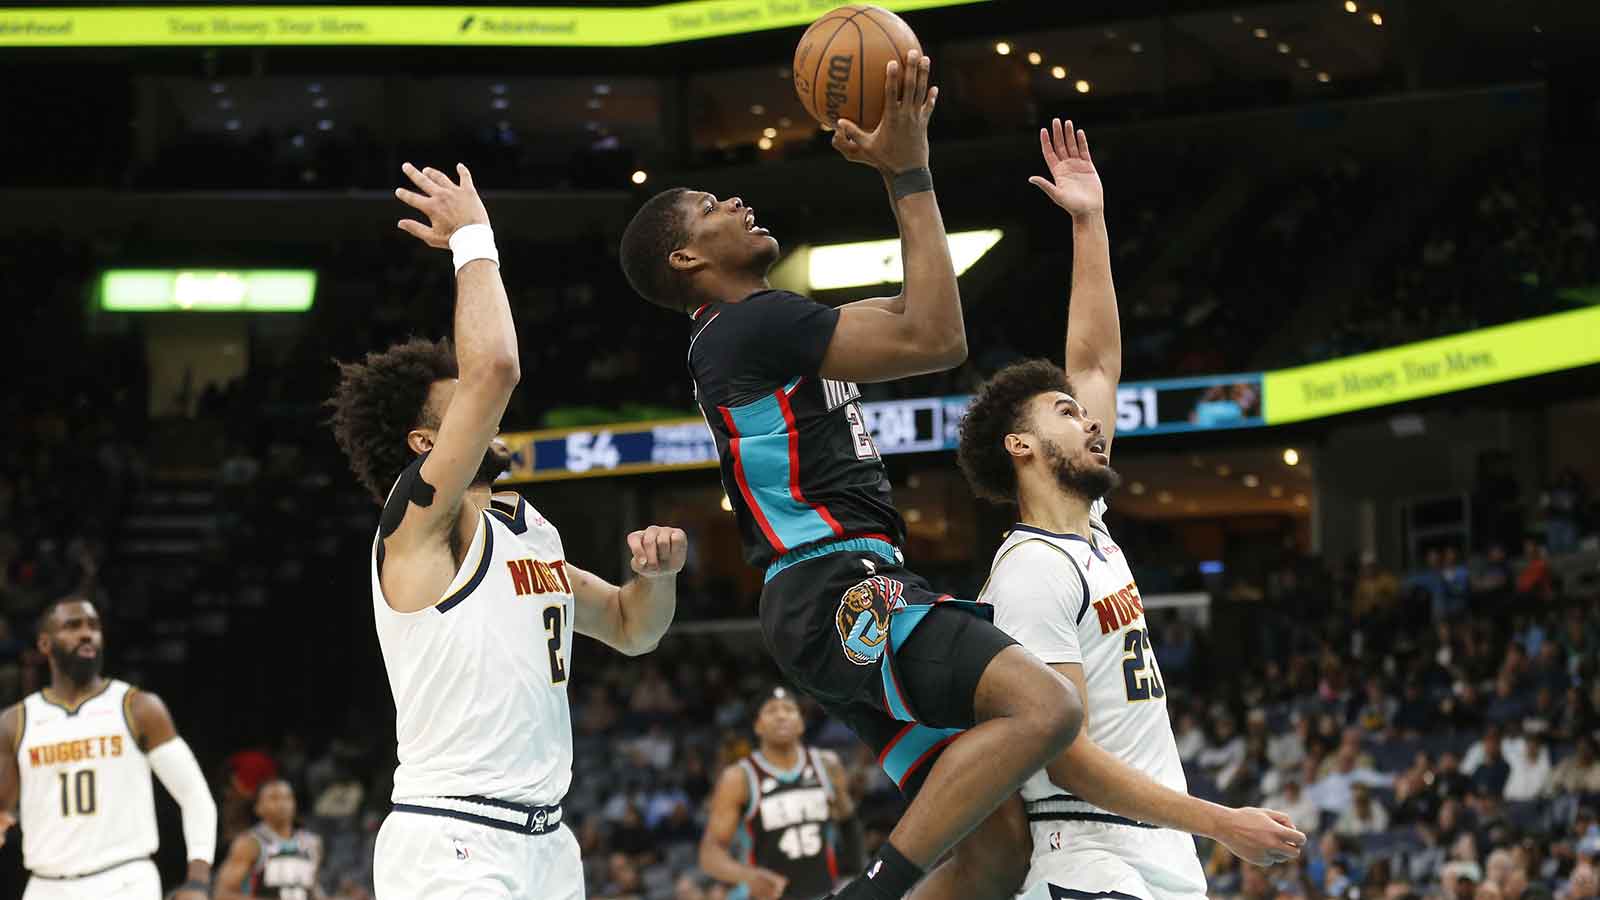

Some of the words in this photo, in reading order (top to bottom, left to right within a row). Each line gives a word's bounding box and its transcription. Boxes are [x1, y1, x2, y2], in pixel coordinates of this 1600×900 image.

[1301, 381, 1337, 404] Your
[1403, 359, 1442, 384] Your
[844, 400, 882, 461] 2
[1116, 387, 1158, 431] 51
[565, 431, 620, 472] 54
[28, 735, 122, 766] NUGGETS
[58, 769, 97, 816] 10
[778, 823, 822, 860] 45
